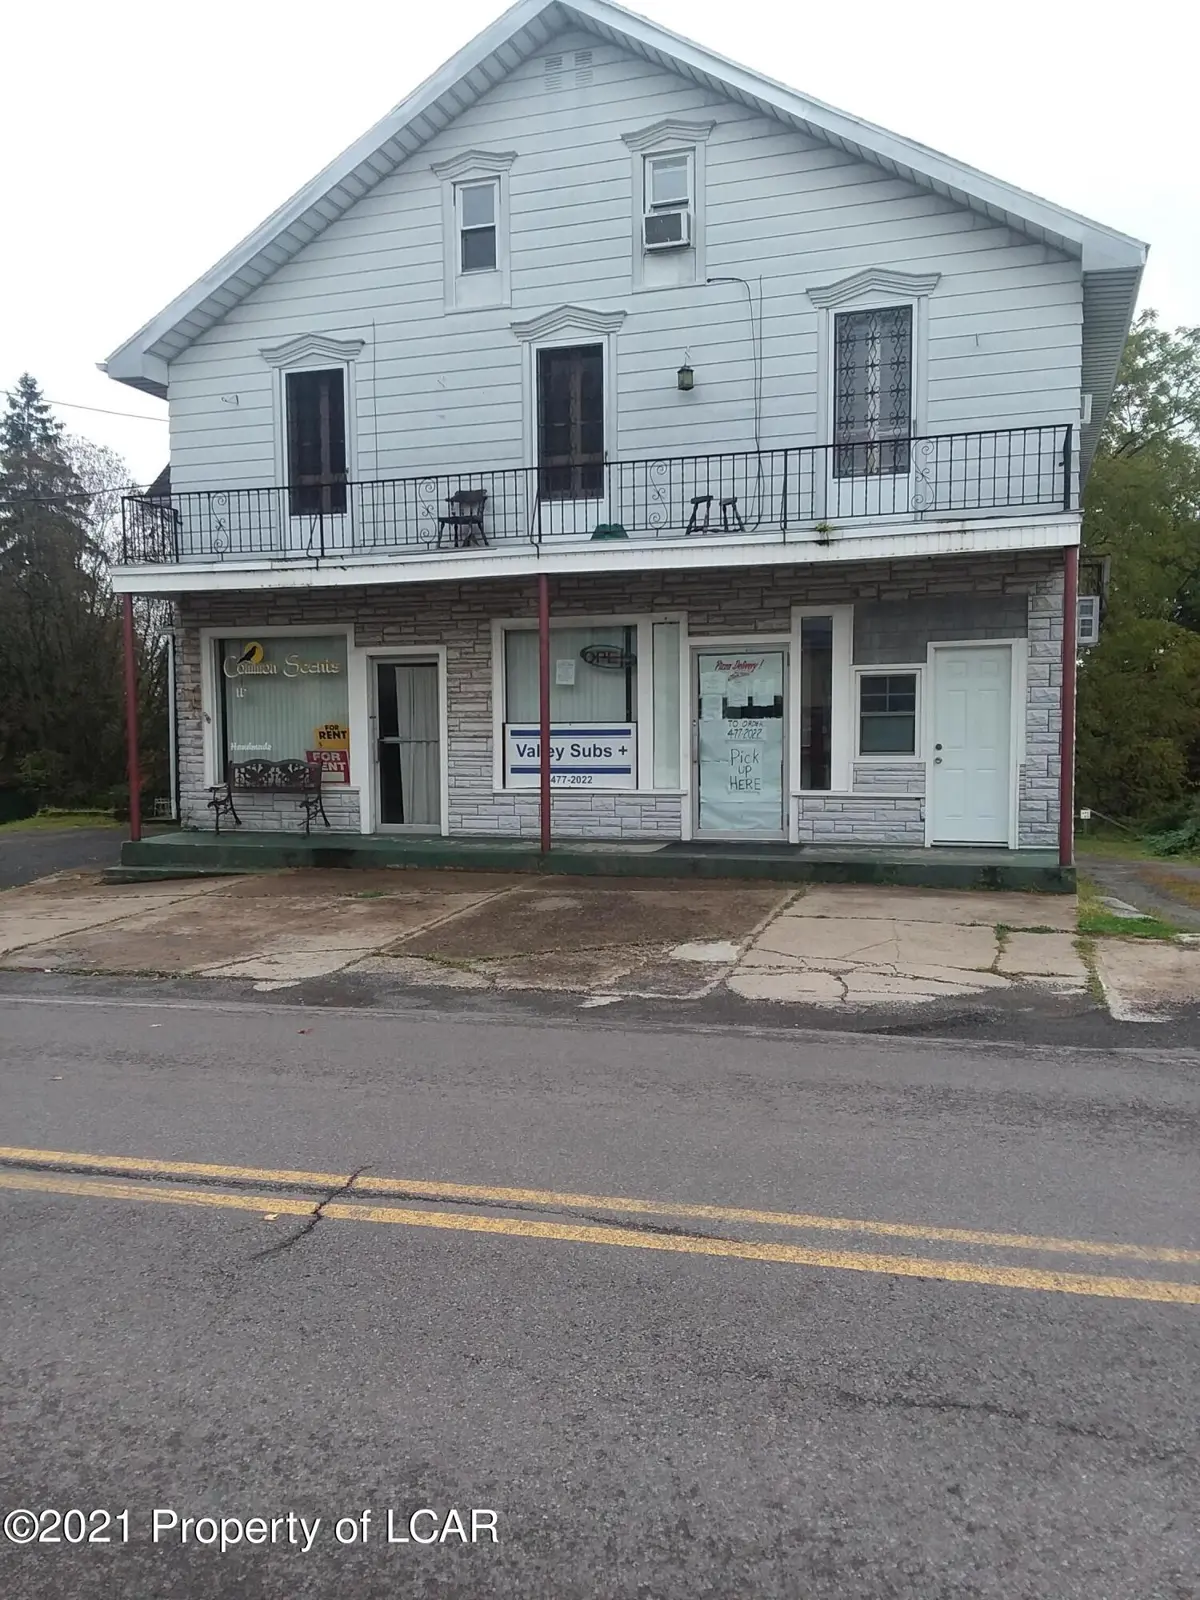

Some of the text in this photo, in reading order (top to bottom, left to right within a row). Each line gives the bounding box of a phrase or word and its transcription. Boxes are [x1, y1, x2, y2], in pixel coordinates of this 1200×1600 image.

[223, 653, 340, 678] Common Scents
[727, 720, 738, 728] TO
[319, 731, 347, 740] RENT
[230, 742, 272, 751] Handmade
[312, 752, 341, 761] FOR
[516, 744, 565, 761] Valey
[570, 744, 613, 758] Subs
[730, 748, 759, 766] Pick
[314, 762, 346, 772] ENT
[550, 775, 593, 785] 477-2022
[729, 776, 762, 791] HERE
